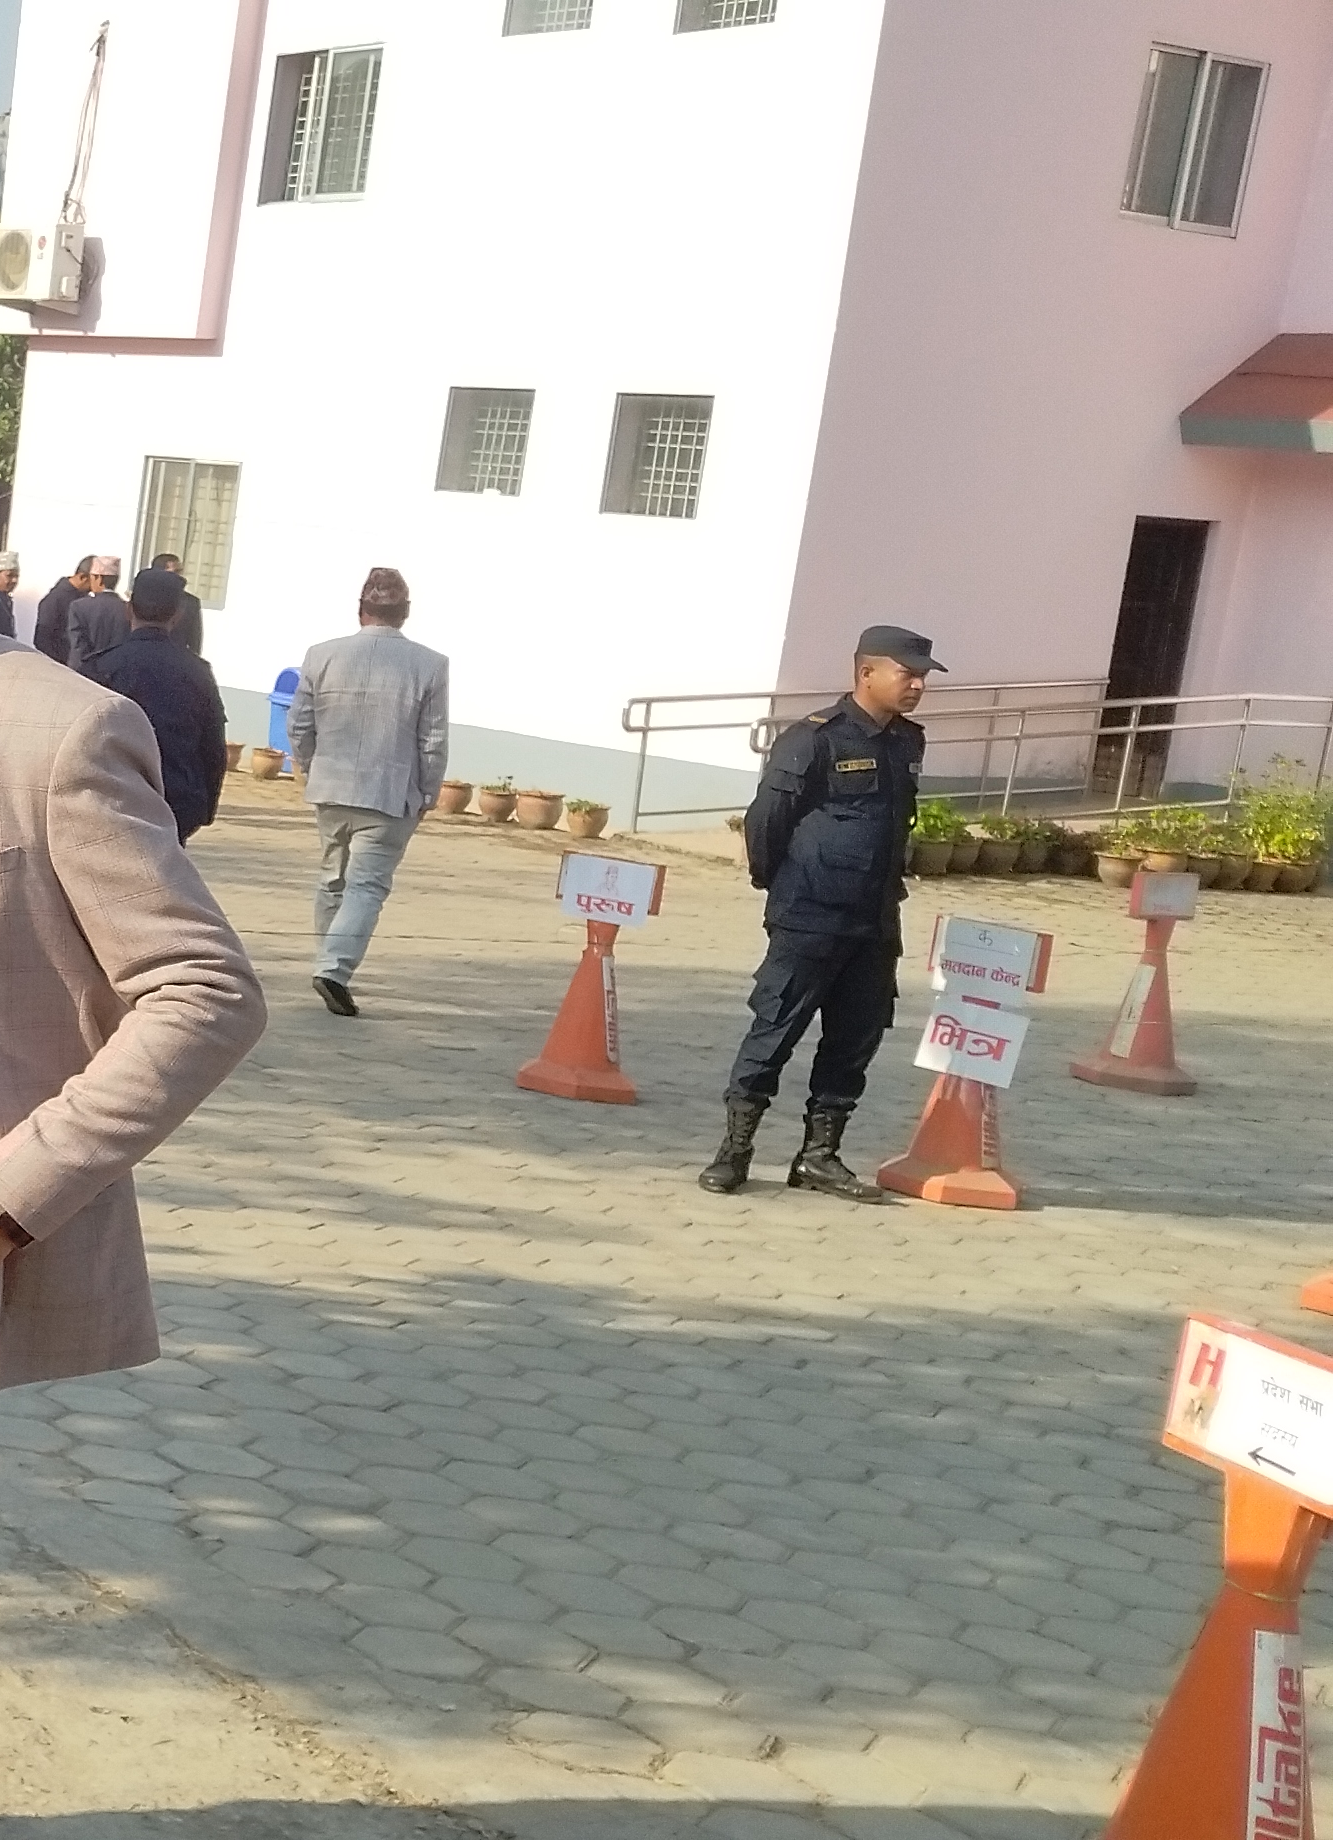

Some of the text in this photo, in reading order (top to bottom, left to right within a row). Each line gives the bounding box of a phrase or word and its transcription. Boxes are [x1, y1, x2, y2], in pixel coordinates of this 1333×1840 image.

[940, 958, 988, 978] मतदान
[929, 1014, 1012, 1061] भित्र
[1261, 1376, 1324, 1417] प्रदेश सभा
